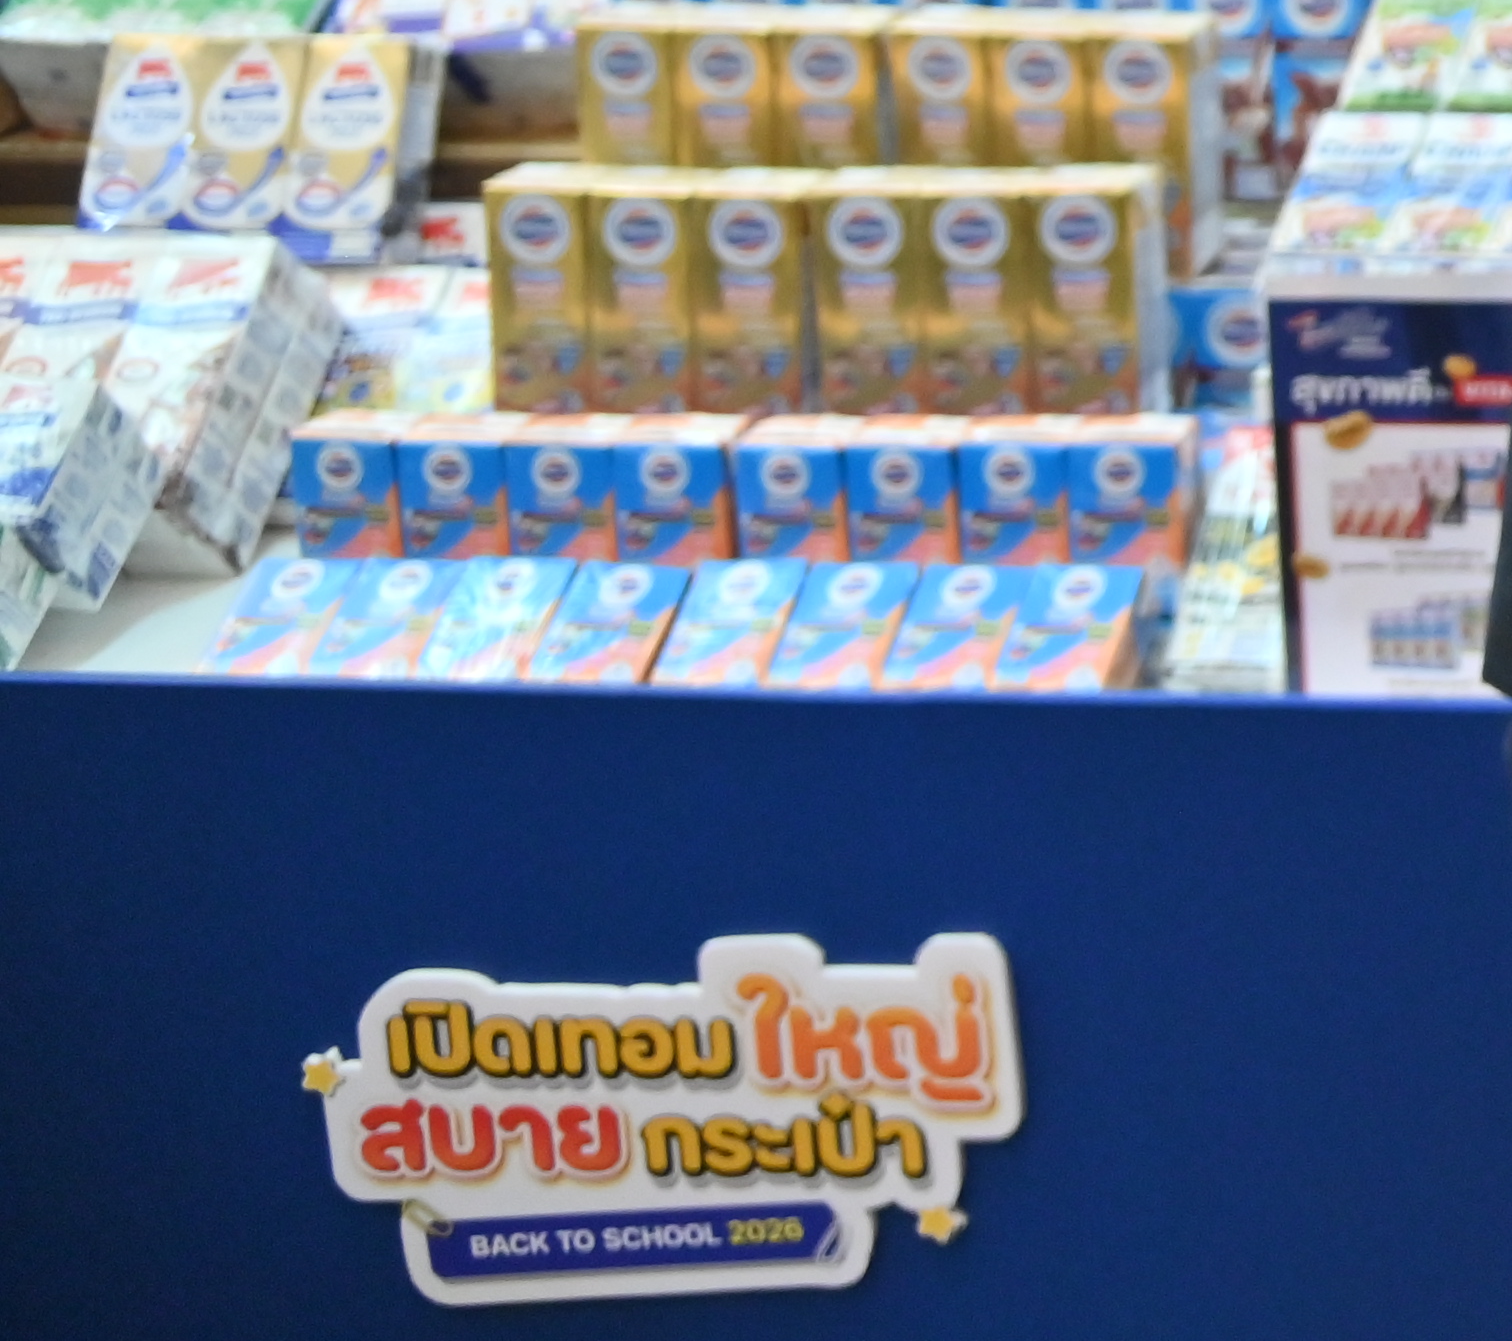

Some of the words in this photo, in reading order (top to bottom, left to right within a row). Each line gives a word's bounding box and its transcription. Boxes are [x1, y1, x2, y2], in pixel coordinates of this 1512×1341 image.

[387, 1000, 735, 1079] เปิดเทอม
[737, 972, 990, 1103] ใหญ่
[360, 1098, 622, 1174] สบาย
[641, 1092, 928, 1177] กระเป๋า
[469, 1231, 552, 1259] BACK
[558, 1228, 597, 1254] TO
[602, 1223, 722, 1253] SCHOOL
[727, 1217, 805, 1246] 2026
